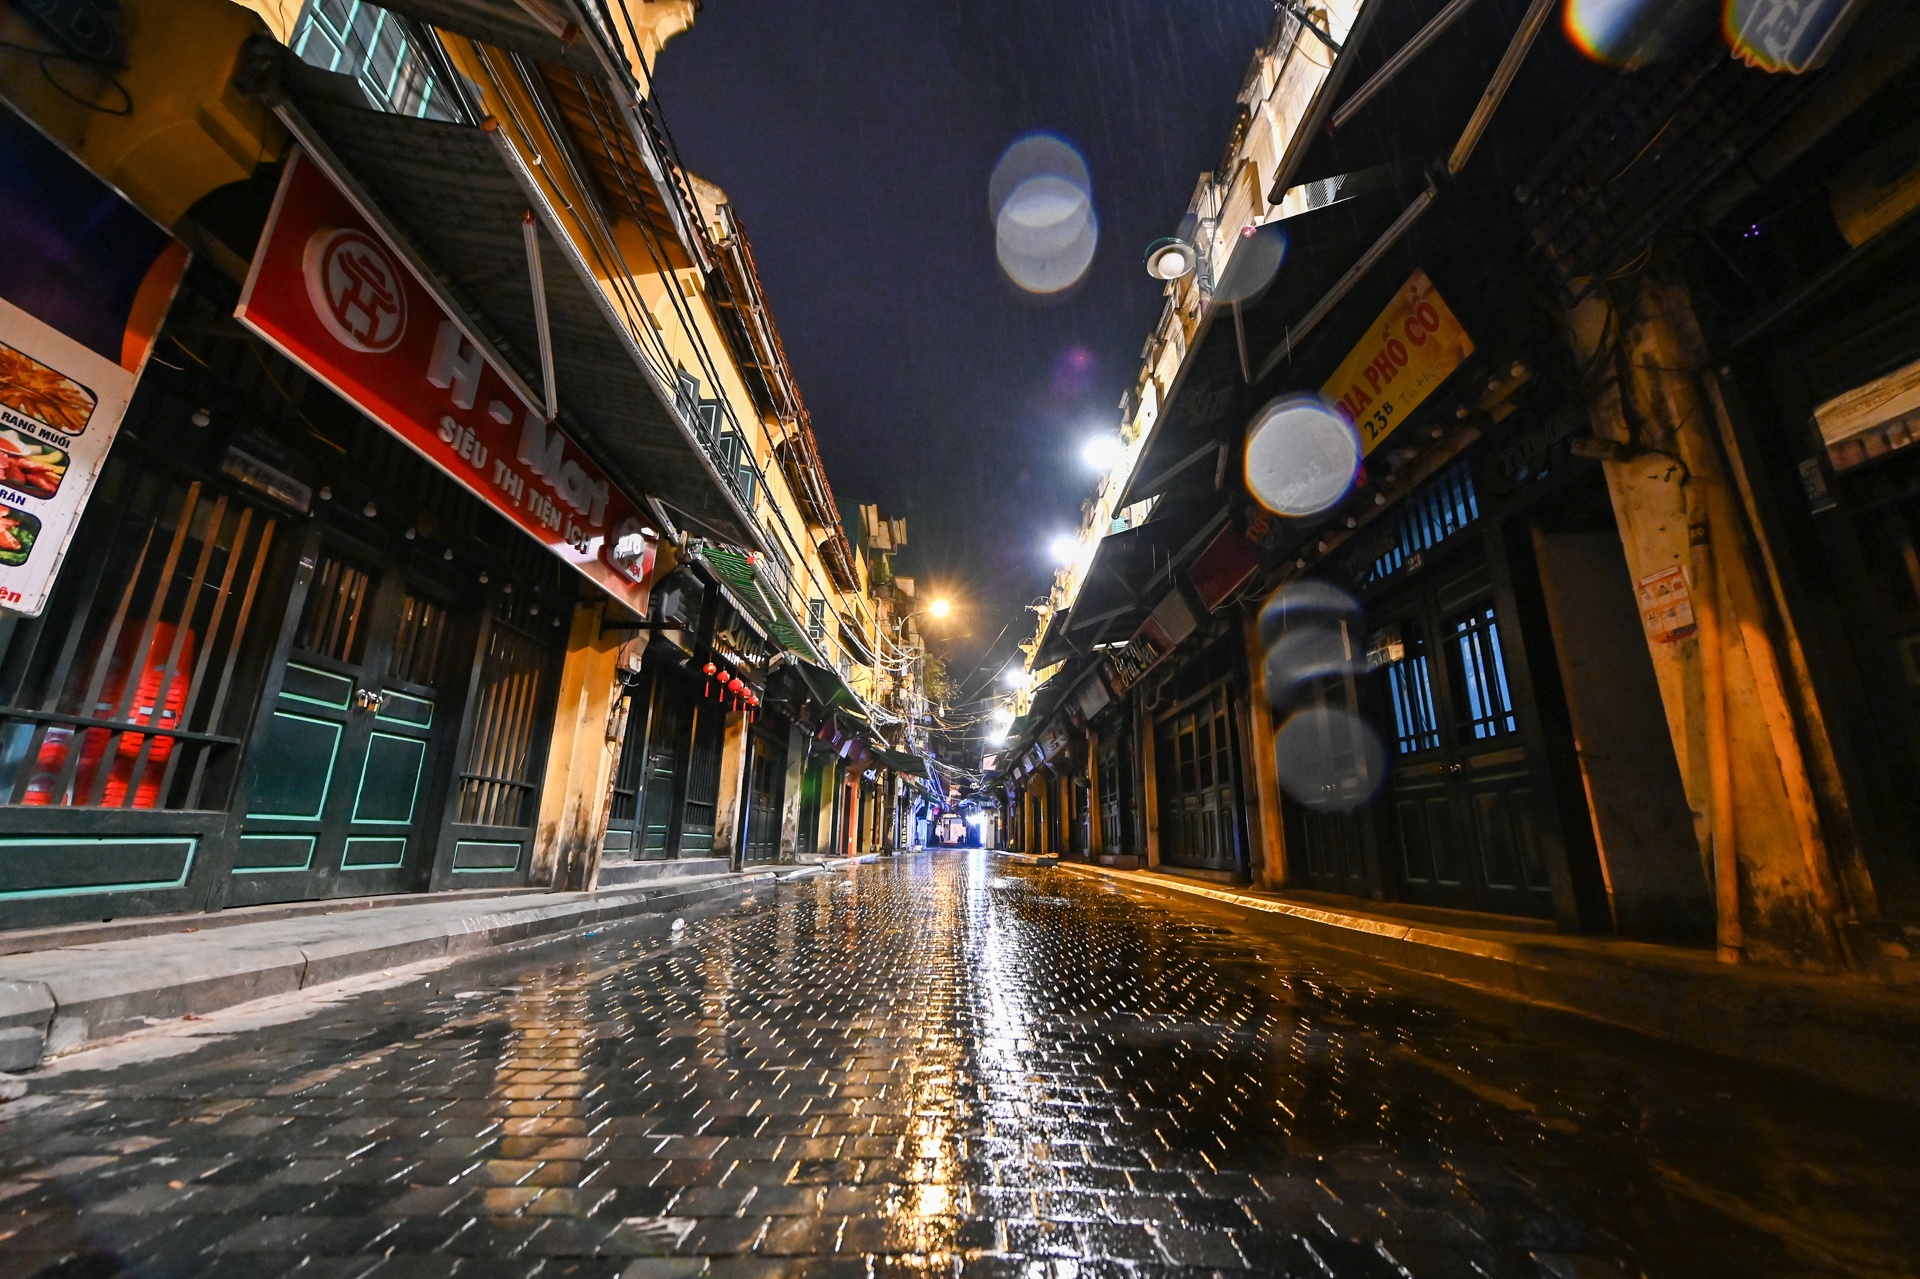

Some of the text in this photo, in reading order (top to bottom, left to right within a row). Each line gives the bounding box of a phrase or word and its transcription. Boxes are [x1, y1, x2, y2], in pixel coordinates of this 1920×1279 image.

[426, 320, 484, 410] H
[516, 408, 610, 528] Mart
[1335, 383, 1373, 425] BIA
[0, 411, 71, 449] RANG MUỐI
[0, 489, 26, 506] RÁN
[437, 415, 488, 469] SIÊU
[493, 458, 524, 507] THỊ
[527, 487, 562, 532] TIỆN
[564, 513, 592, 554] ÍCH
